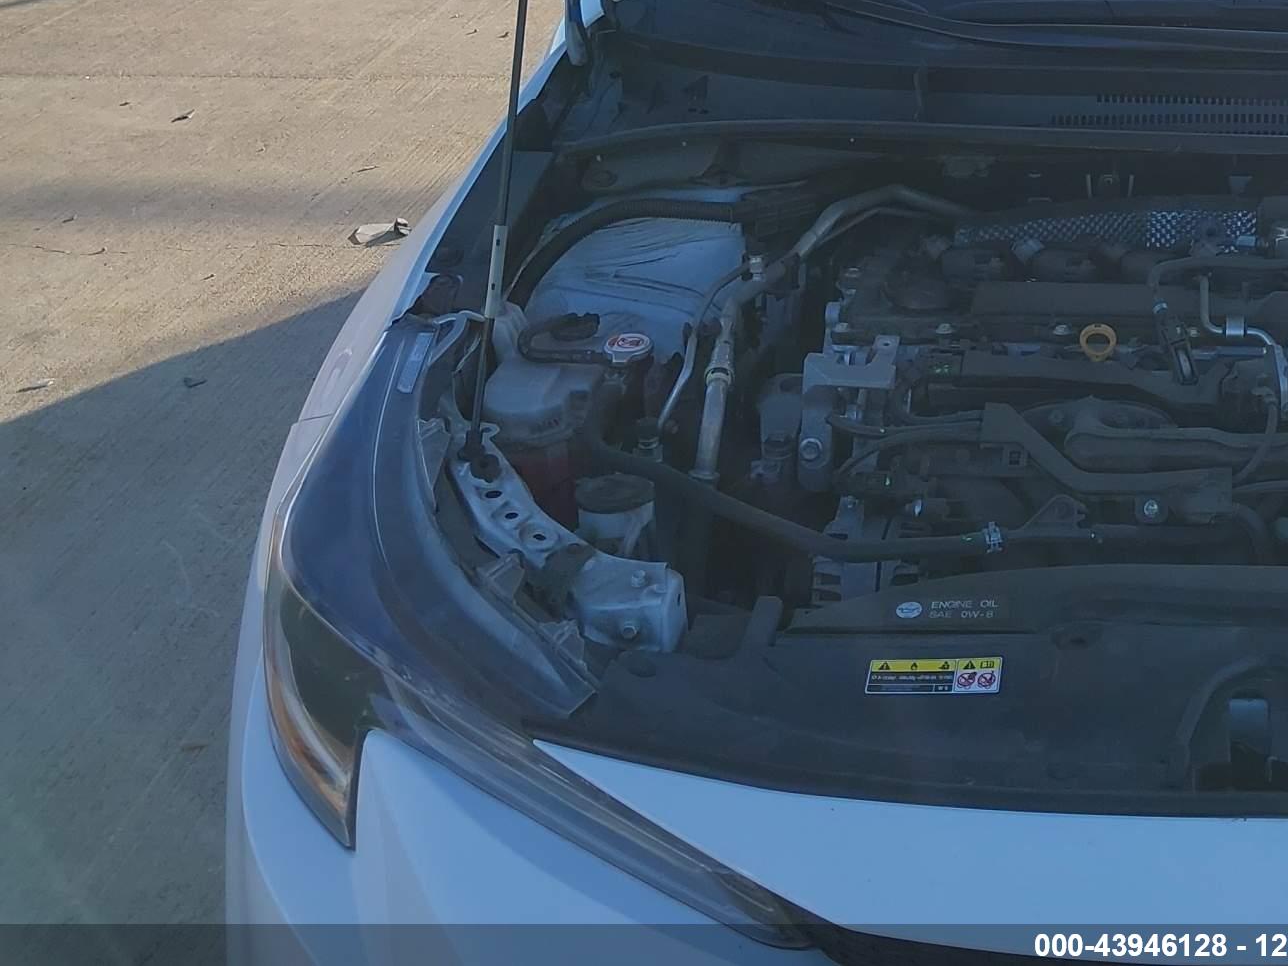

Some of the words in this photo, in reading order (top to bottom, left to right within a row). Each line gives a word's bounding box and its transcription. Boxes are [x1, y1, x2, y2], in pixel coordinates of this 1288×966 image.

[931, 600, 973, 609] ENGINE
[980, 599, 998, 608] OIL
[928, 610, 952, 618] SAE
